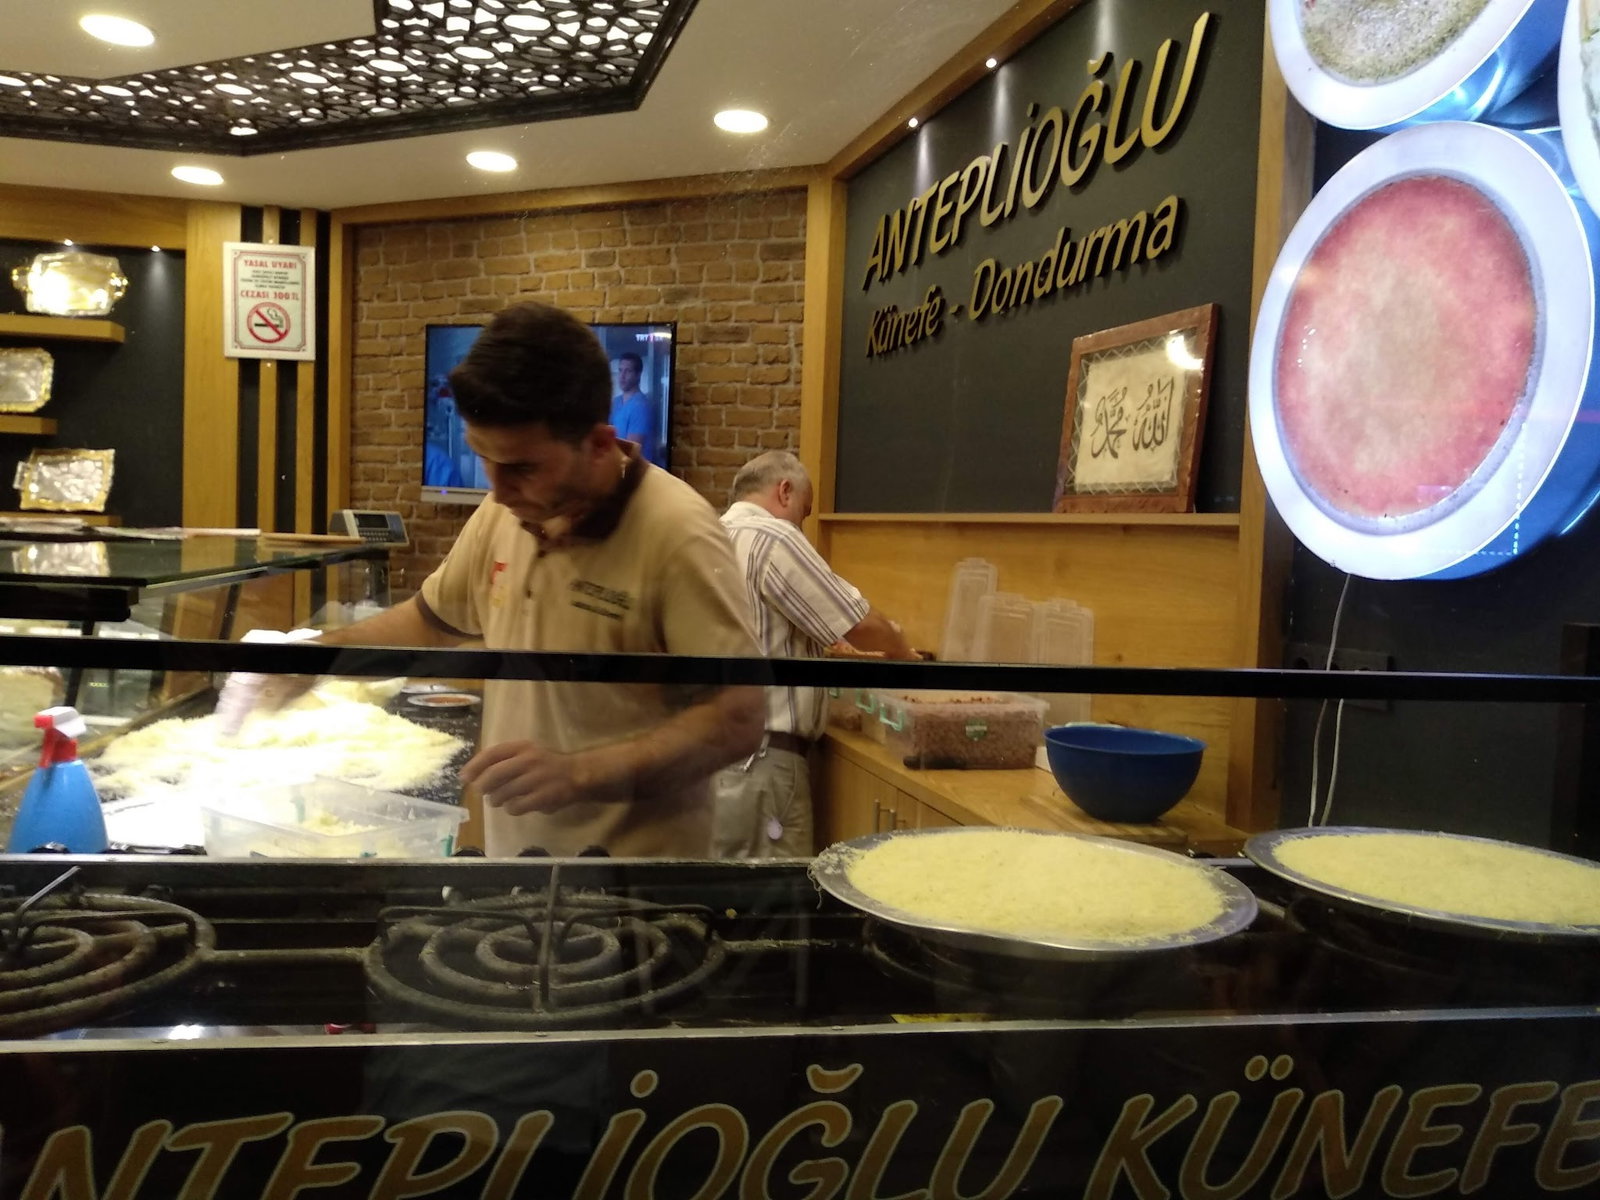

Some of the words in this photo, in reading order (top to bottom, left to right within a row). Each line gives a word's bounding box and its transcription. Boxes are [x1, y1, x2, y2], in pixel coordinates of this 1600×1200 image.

[862, 12, 1211, 290] ANTEPLİOĞLU
[244, 260, 268, 268] YASAL
[271, 261, 297, 269] UYARI
[865, 284, 943, 357] Künefe
[969, 195, 1180, 321] Dondurma
[0, 1063, 1063, 1200] NTEPLİOĞLU
[1088, 1053, 1600, 1200] KÜNEFE
